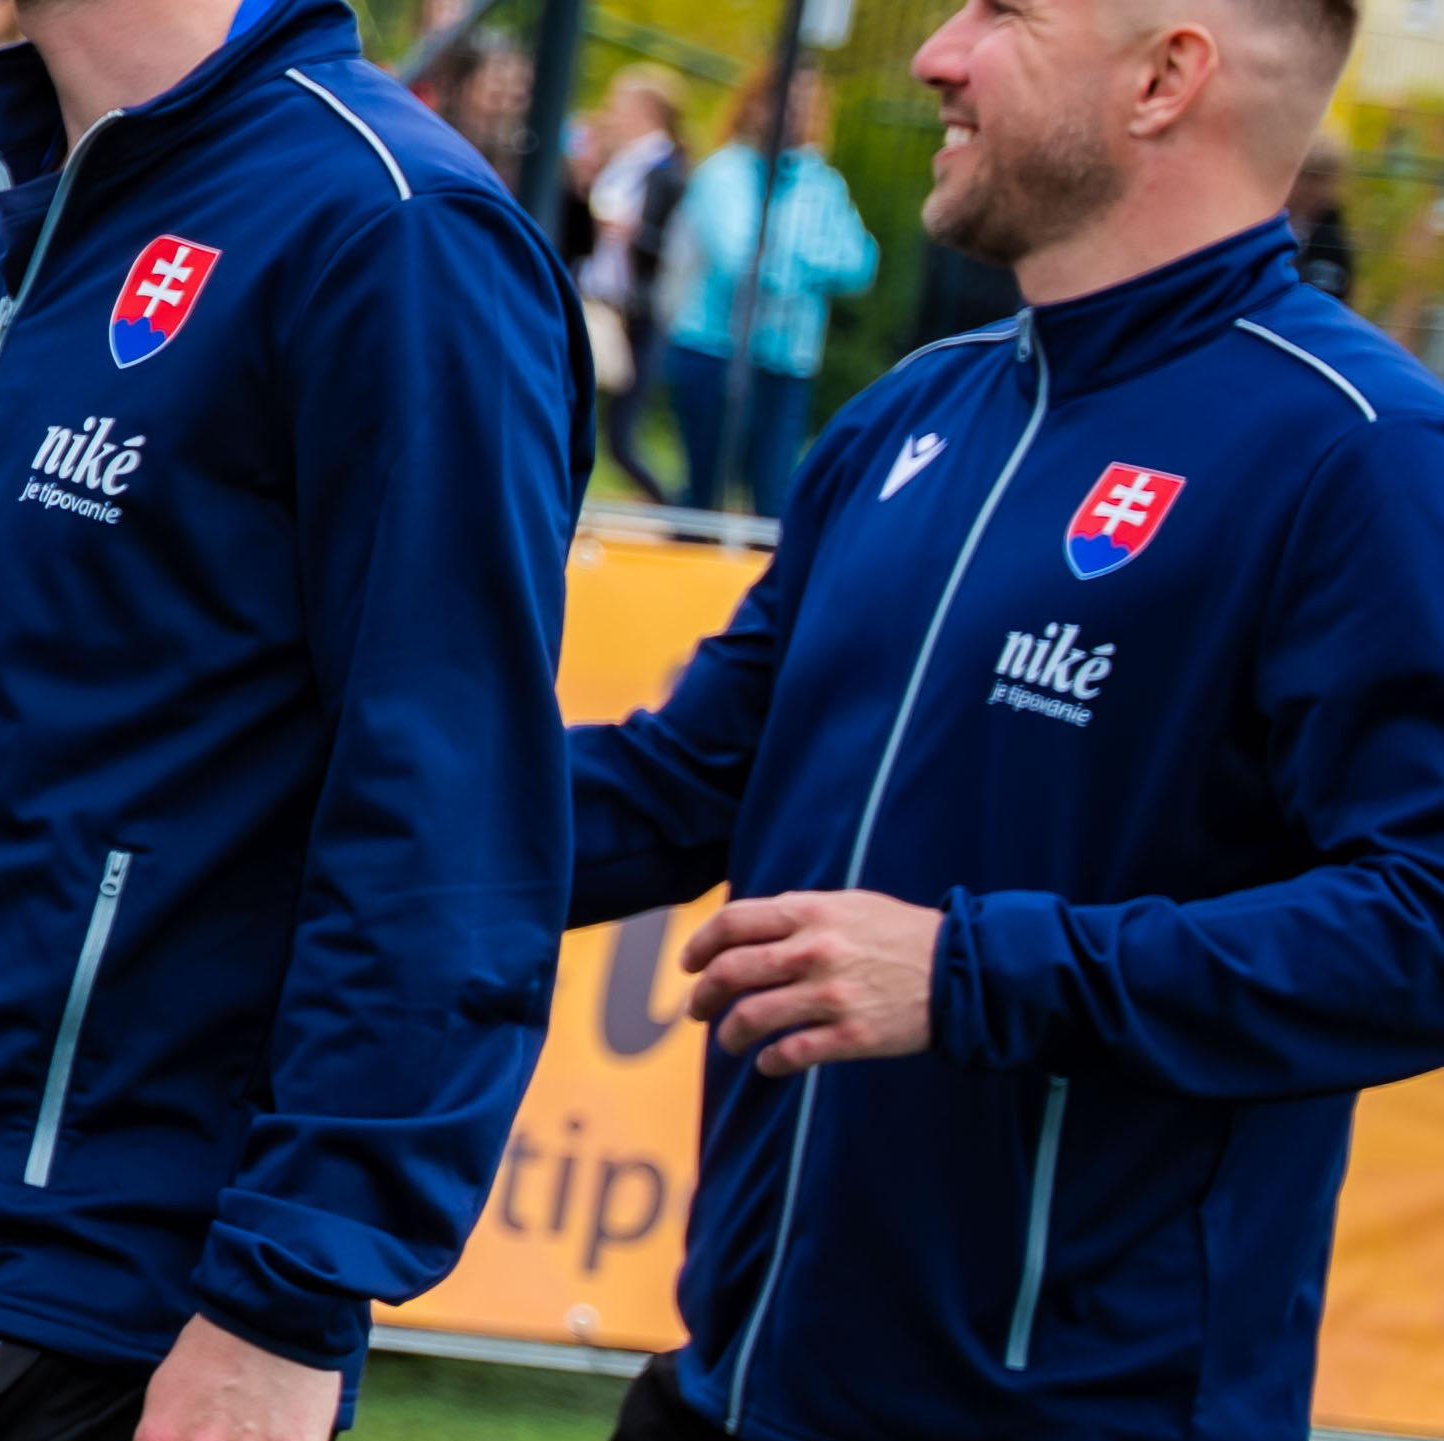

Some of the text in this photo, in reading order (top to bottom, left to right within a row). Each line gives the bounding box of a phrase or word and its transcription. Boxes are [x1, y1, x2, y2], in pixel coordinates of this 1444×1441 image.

[31, 416, 147, 496] niké
[38, 482, 123, 525] tipovanie
[994, 621, 1117, 700] niké
[498, 1117, 677, 1274] tip
